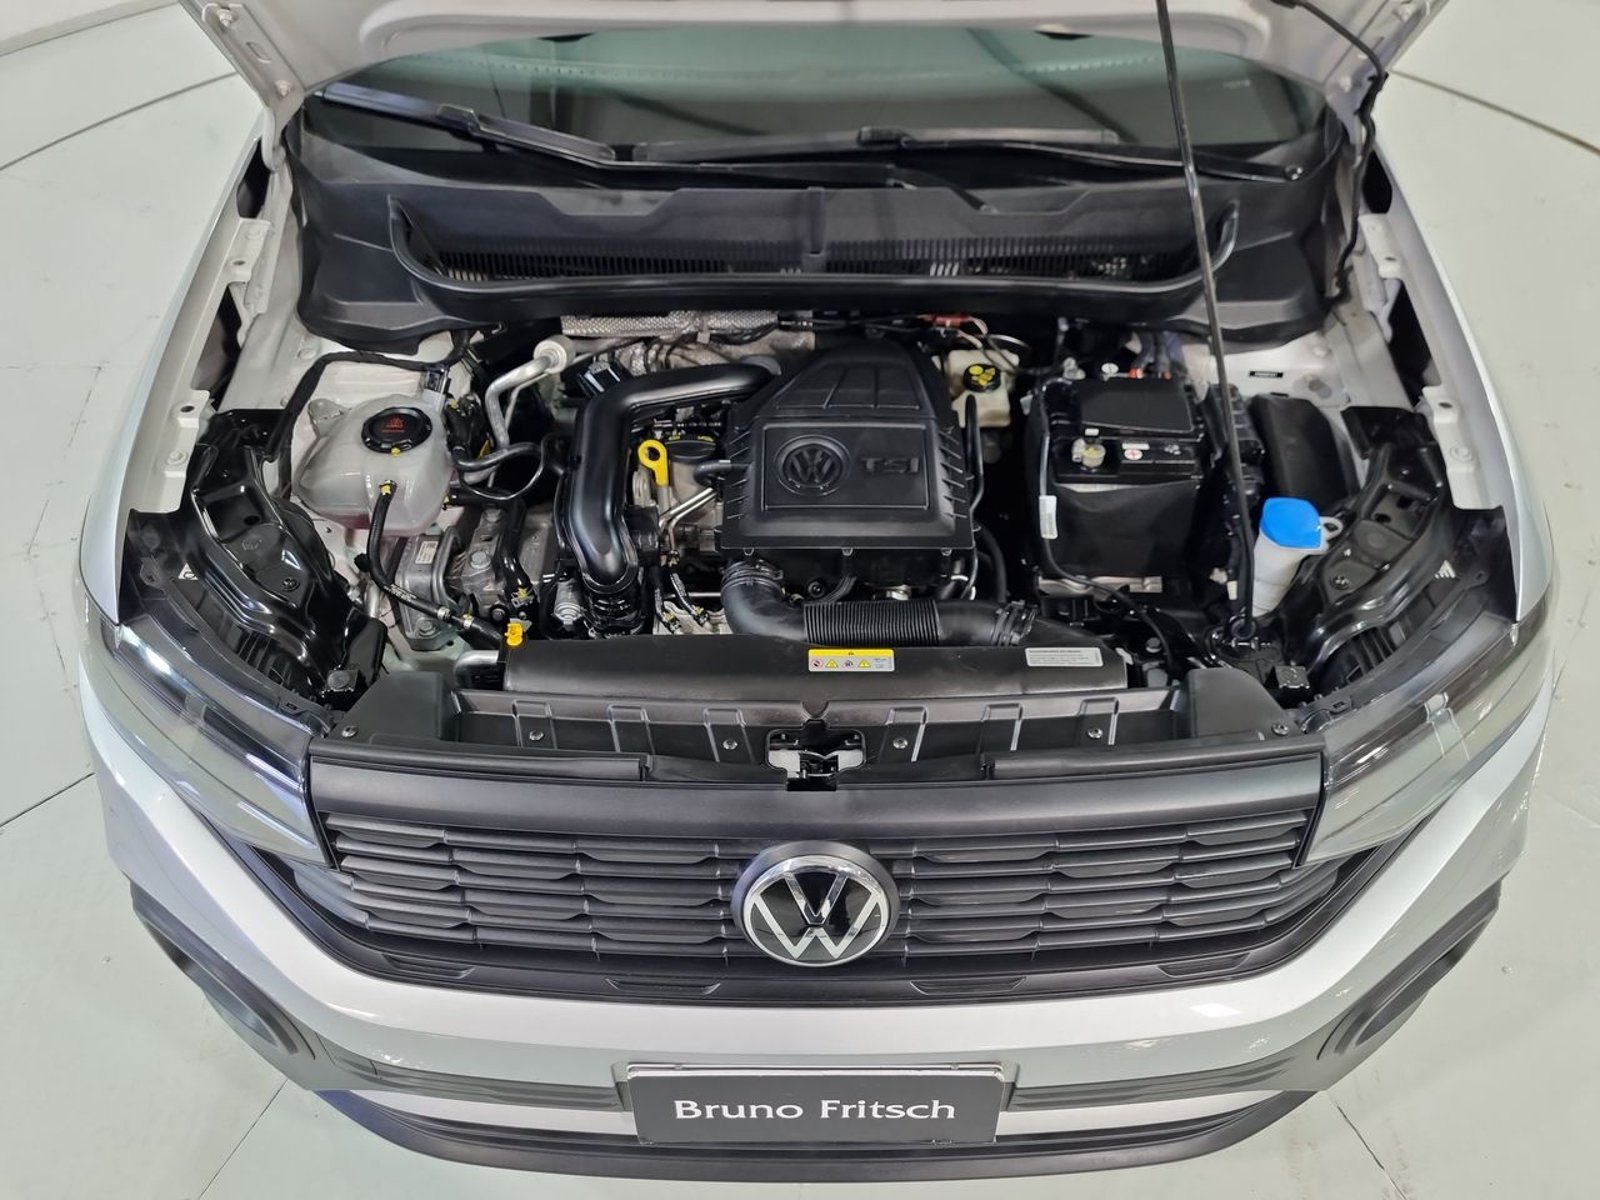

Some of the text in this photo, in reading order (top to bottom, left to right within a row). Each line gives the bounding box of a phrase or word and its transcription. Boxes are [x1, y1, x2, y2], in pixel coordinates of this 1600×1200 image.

[861, 456, 920, 474] TSI
[750, 867, 883, 962] VW
[674, 1099, 956, 1119] Bruno Fritsch
